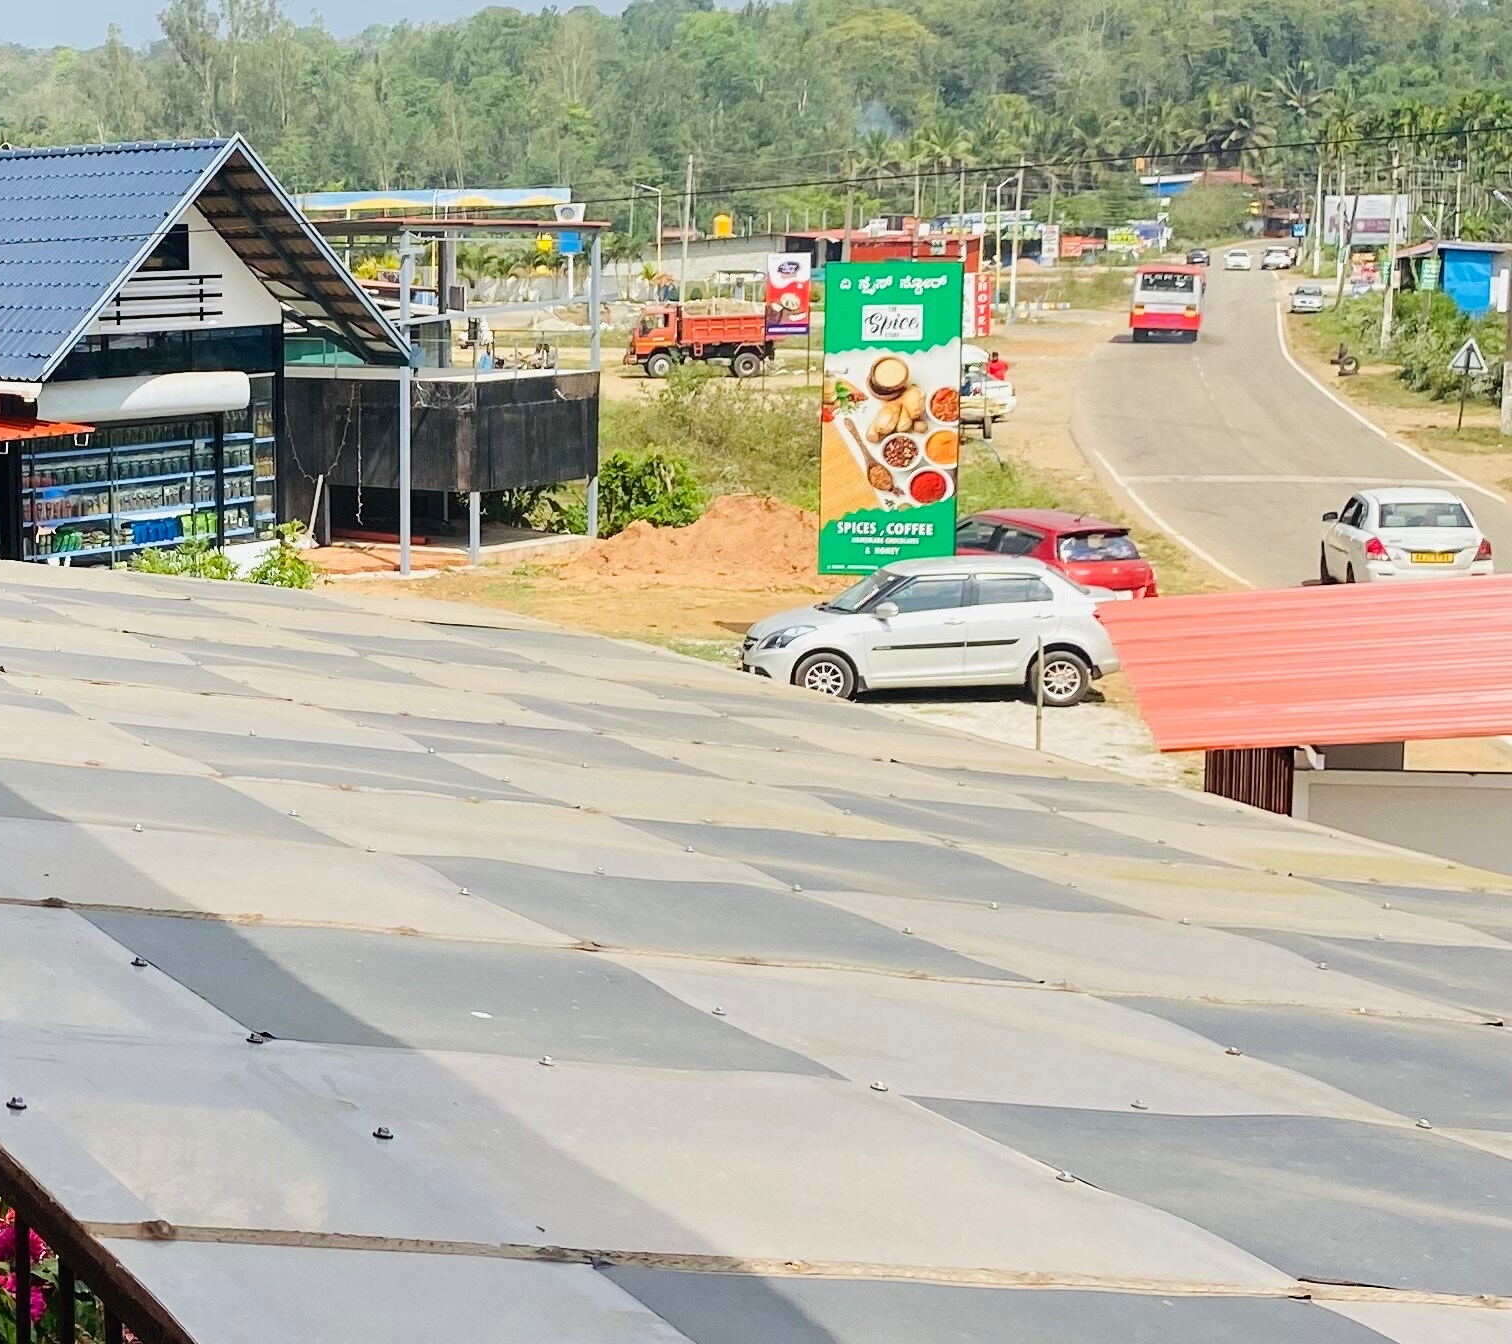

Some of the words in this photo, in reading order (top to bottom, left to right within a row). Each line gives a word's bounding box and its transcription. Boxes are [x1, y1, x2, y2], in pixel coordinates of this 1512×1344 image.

[977, 282, 988, 336] HOTEL
[864, 312, 919, 336] Spice
[837, 521, 877, 535] SPICES
[874, 547, 900, 555] HONEY
